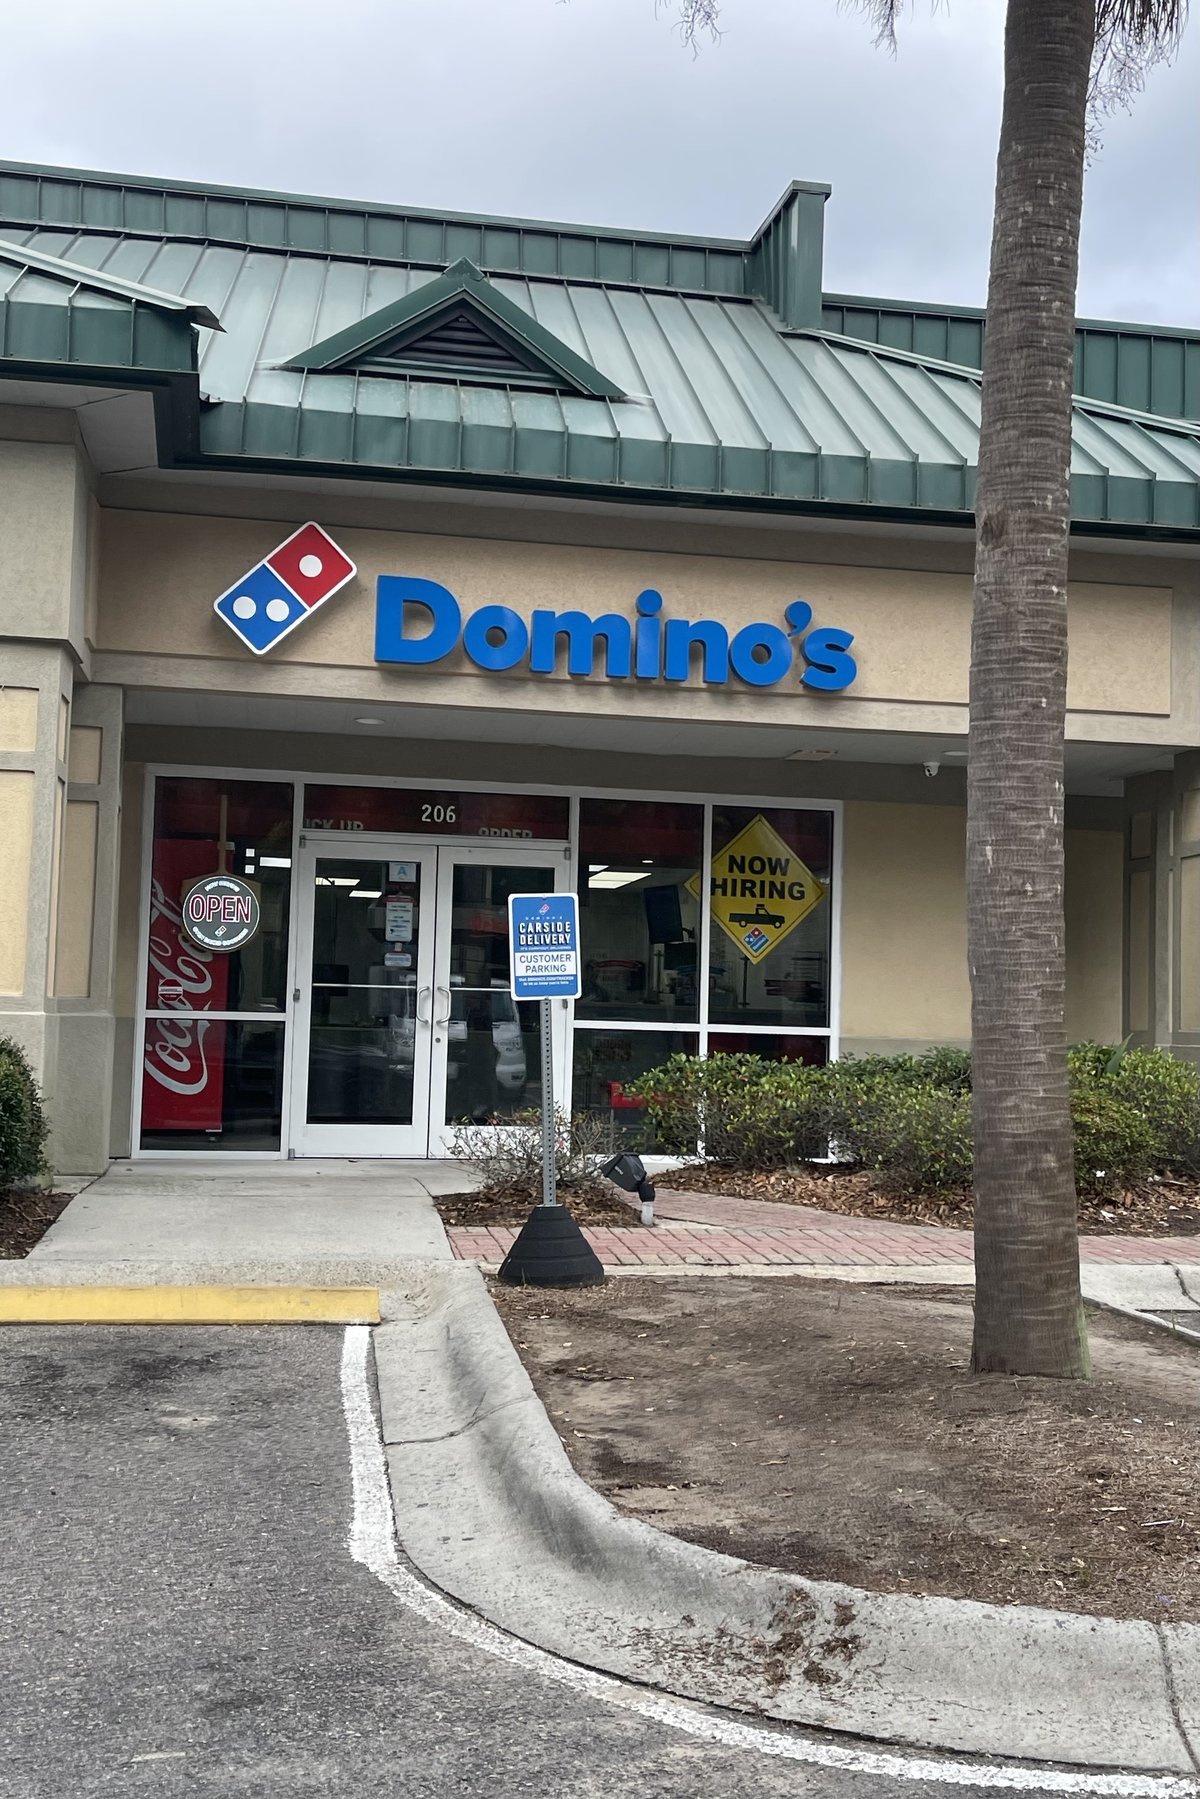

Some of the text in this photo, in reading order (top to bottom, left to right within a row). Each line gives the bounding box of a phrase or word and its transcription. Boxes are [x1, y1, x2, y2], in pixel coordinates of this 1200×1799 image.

[375, 574, 857, 691] Domino's
[421, 804, 456, 823] 206
[305, 817, 334, 829] ICK
[728, 854, 791, 877] NOW
[710, 877, 806, 901] HIRING
[189, 894, 252, 923] OPEN
[519, 921, 571, 933] CARSIDE
[519, 933, 571, 945] DELIVERY
[519, 954, 572, 964] CUSTOMER
[525, 964, 567, 974] PARKING
